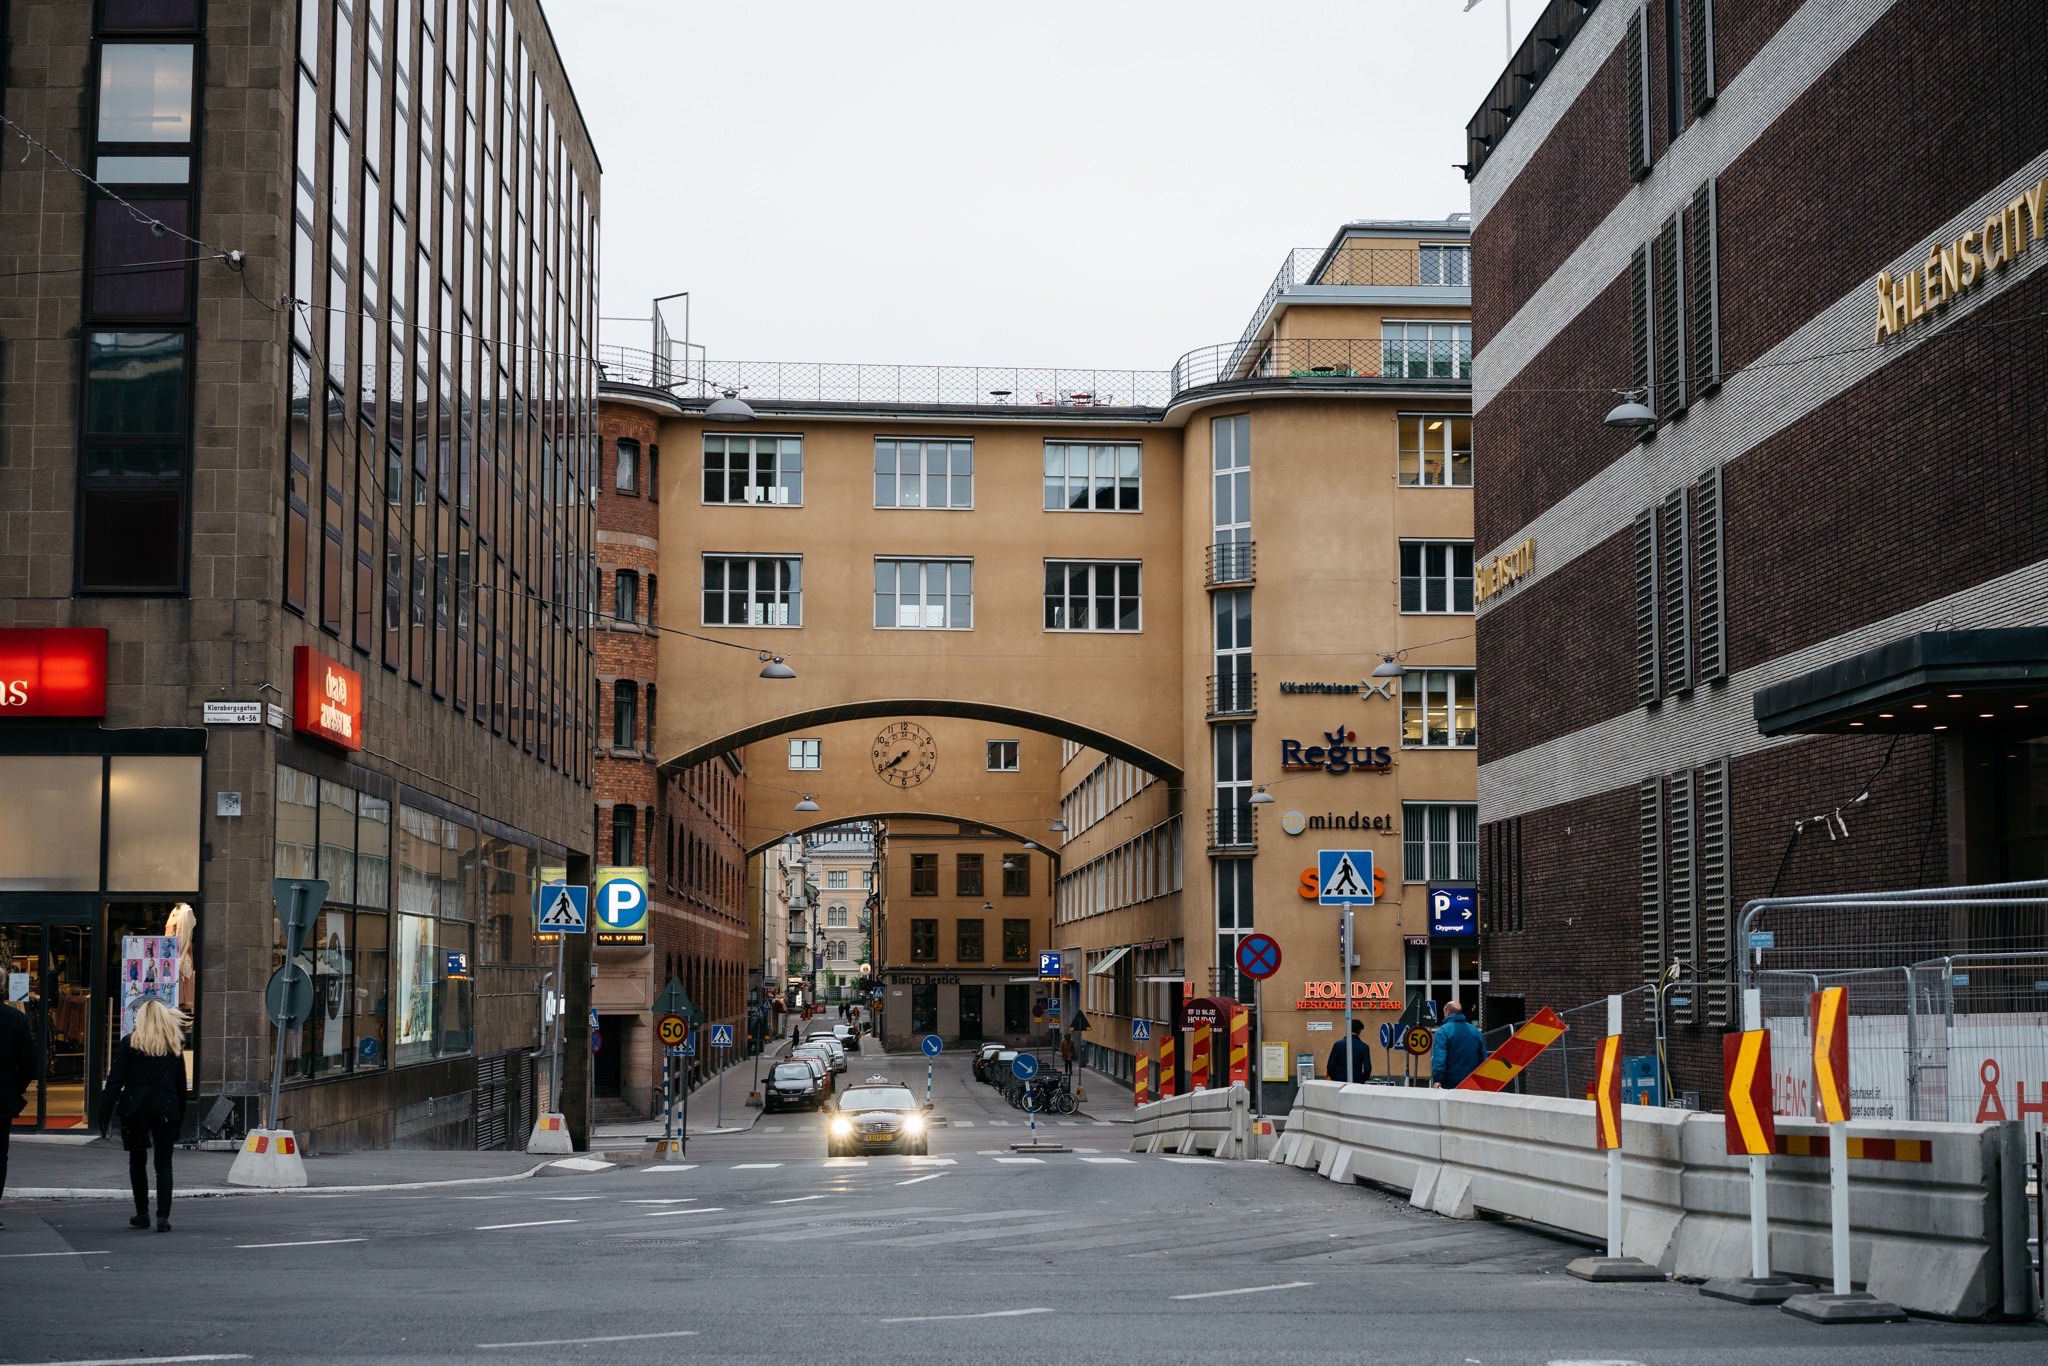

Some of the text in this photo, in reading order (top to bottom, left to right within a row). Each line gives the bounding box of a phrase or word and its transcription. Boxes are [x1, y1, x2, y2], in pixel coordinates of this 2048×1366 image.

[207, 704, 257, 712] Klarabergsgatan
[900, 723, 908, 731] 12
[1281, 738, 1392, 774] Regus
[1308, 811, 1391, 830] mindset
[608, 883, 641, 924] P
[1434, 895, 1451, 920] P
[1304, 981, 1392, 999] HOLDAY
[1296, 1000, 1364, 1009] RESTAURNT
[1380, 1001, 1402, 1009] BAR
[663, 1023, 684, 1038] 50
[1411, 1034, 1429, 1049] 50
[1771, 1067, 1807, 1117] HLÉNS
